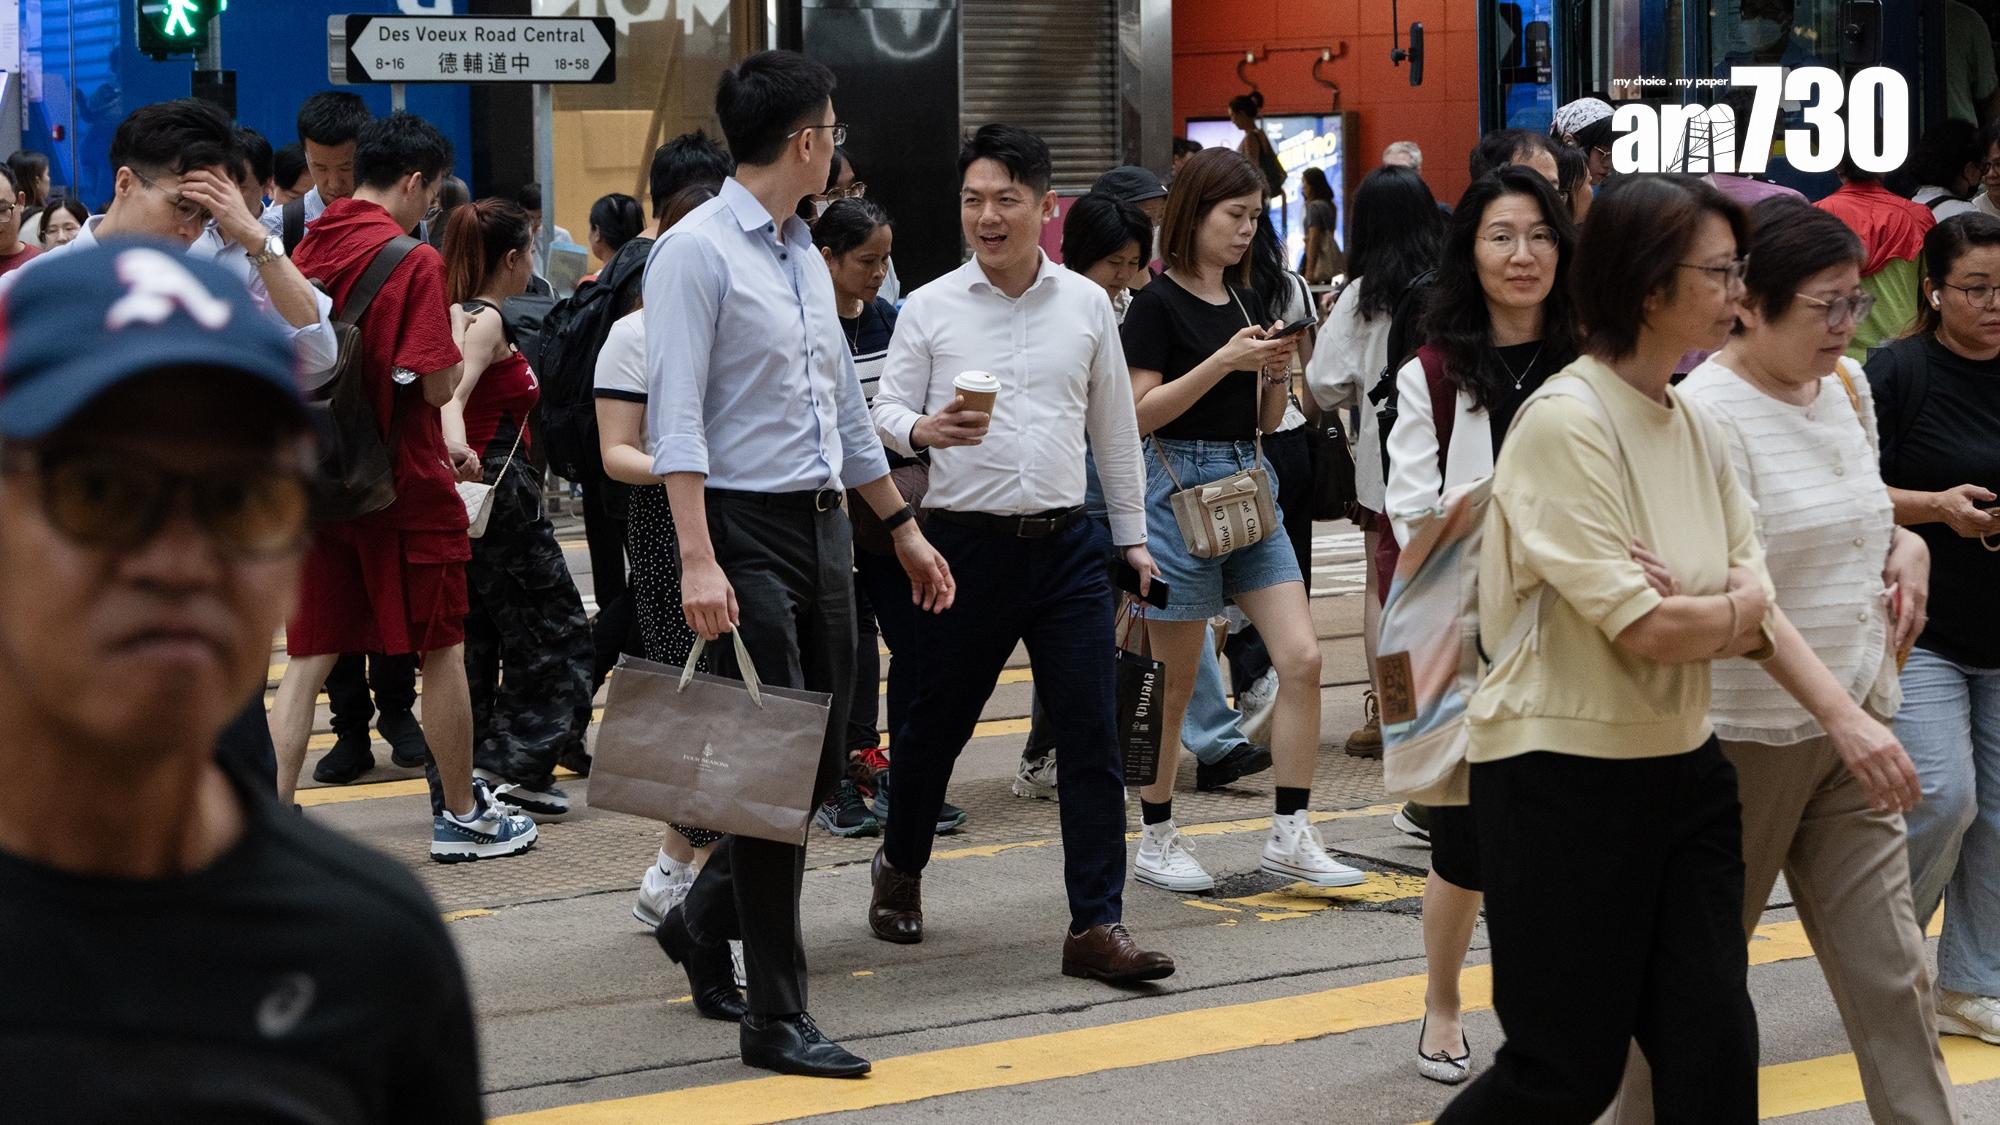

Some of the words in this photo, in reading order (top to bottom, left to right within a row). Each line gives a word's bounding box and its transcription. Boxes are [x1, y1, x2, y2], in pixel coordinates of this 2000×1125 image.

[379, 26, 410, 41] Des
[416, 26, 467, 42] Voeux
[475, 26, 516, 42] Road
[523, 26, 585, 43] Central
[375, 57, 404, 70] 8-16
[438, 52, 530, 74] 德輔道中
[555, 58, 590, 70] 18-58
[1134, 672, 1155, 717] everrich
